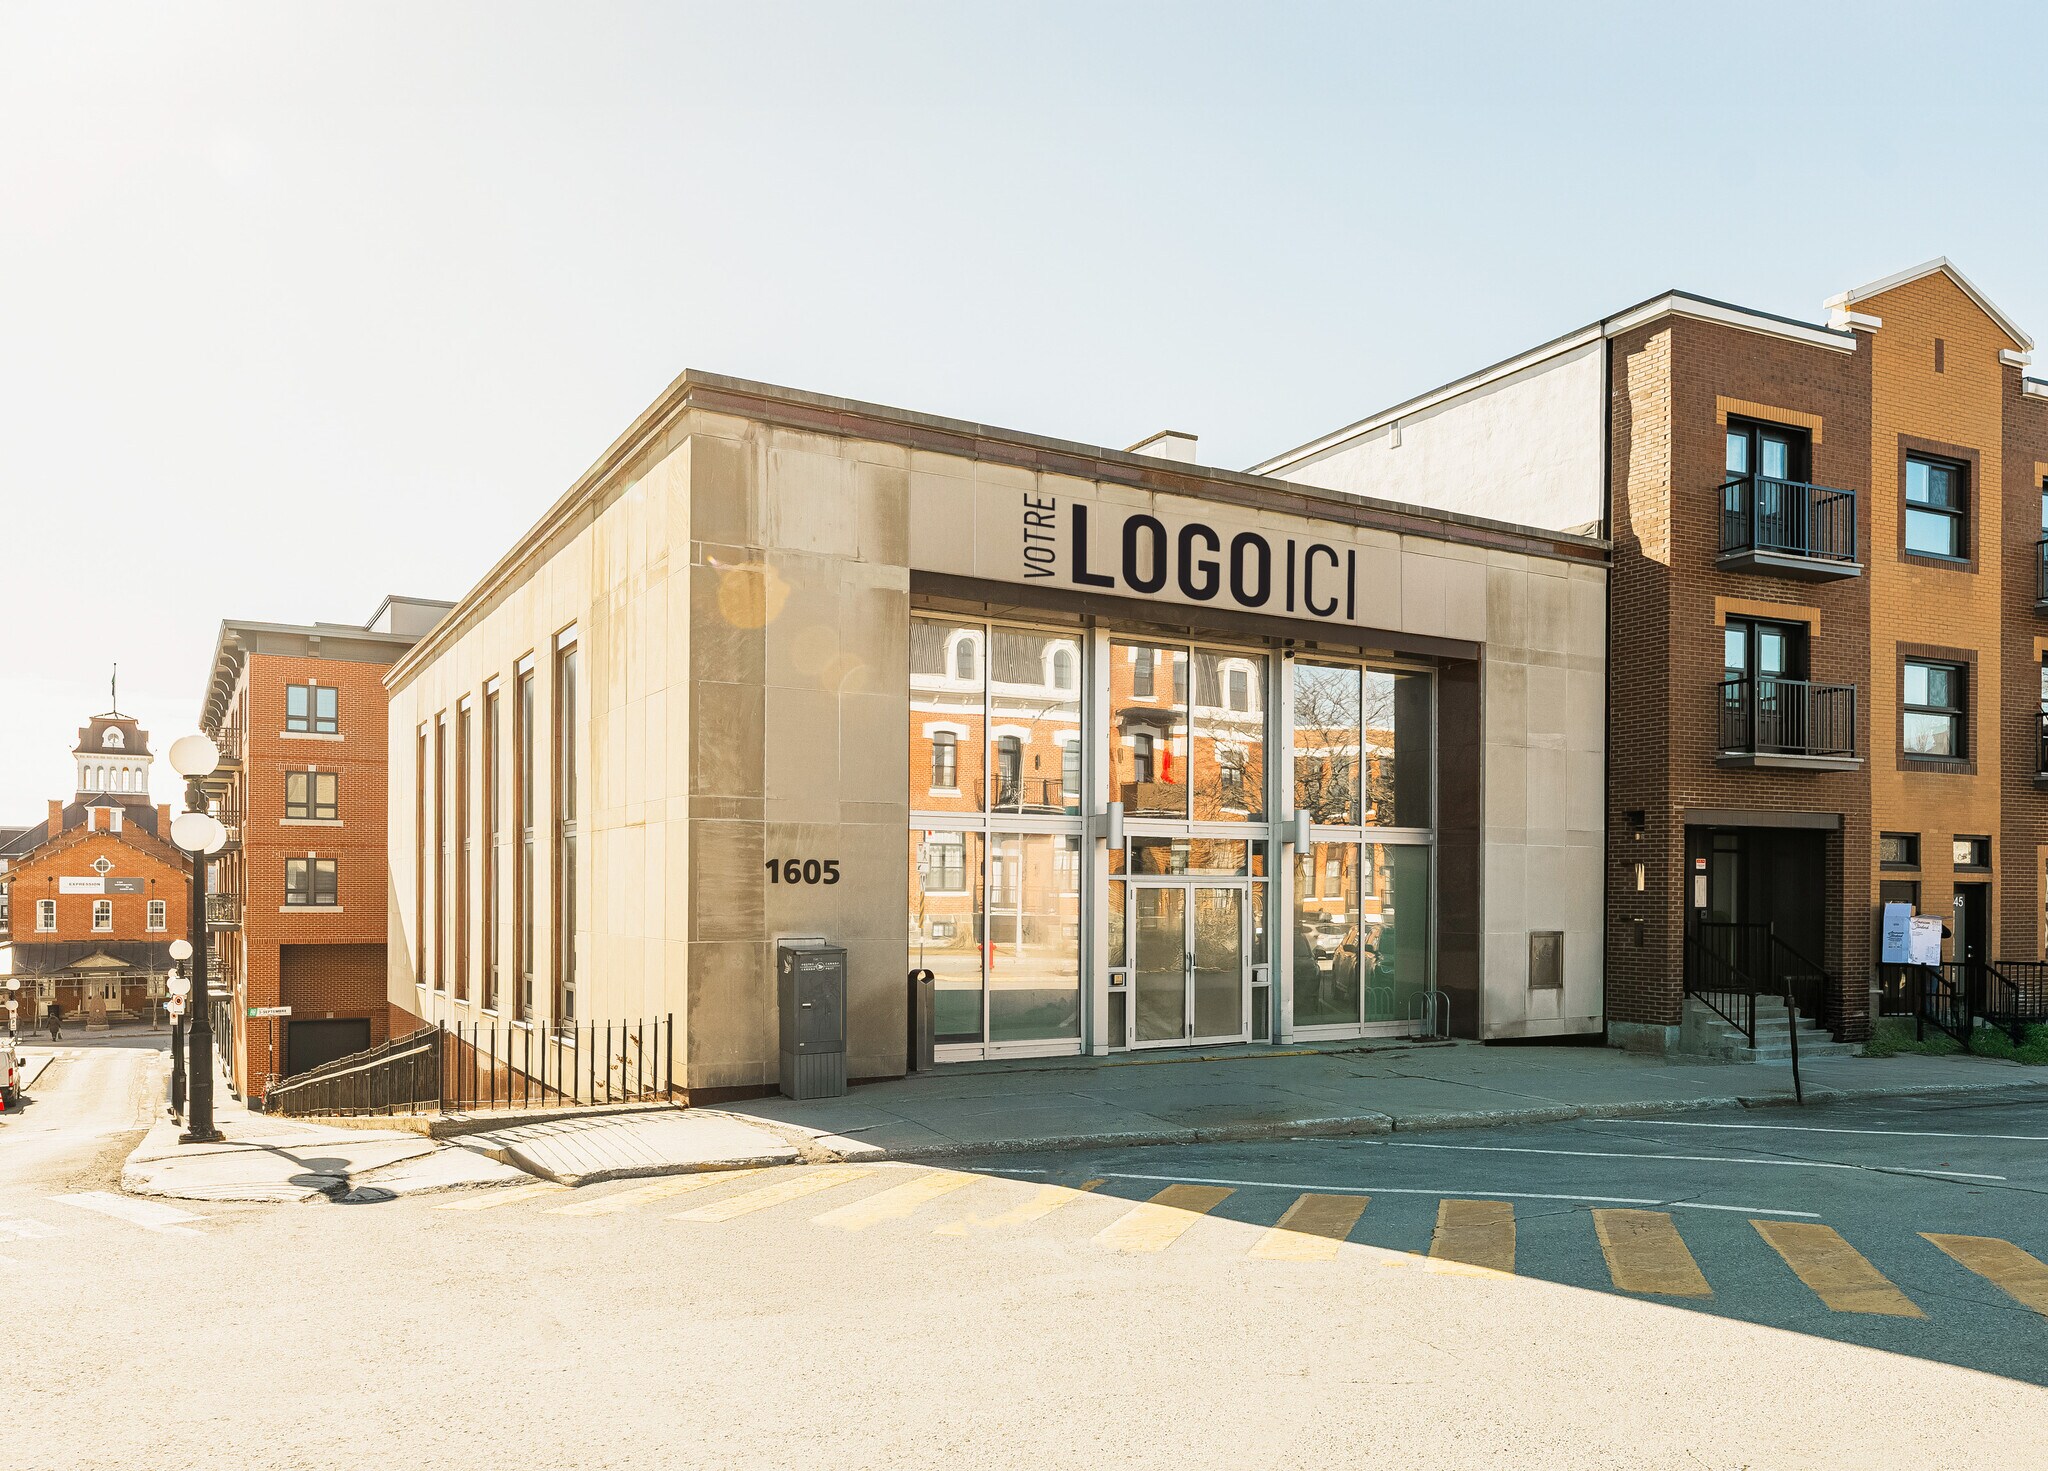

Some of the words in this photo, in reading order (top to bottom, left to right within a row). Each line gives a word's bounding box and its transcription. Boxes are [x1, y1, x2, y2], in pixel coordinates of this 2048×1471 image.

[1024, 493, 1056, 578] VOTRE
[1072, 503, 1272, 608] LOGO
[1286, 539, 1356, 621] ICI
[765, 859, 840, 885] 1605
[1953, 896, 1964, 908] 45
